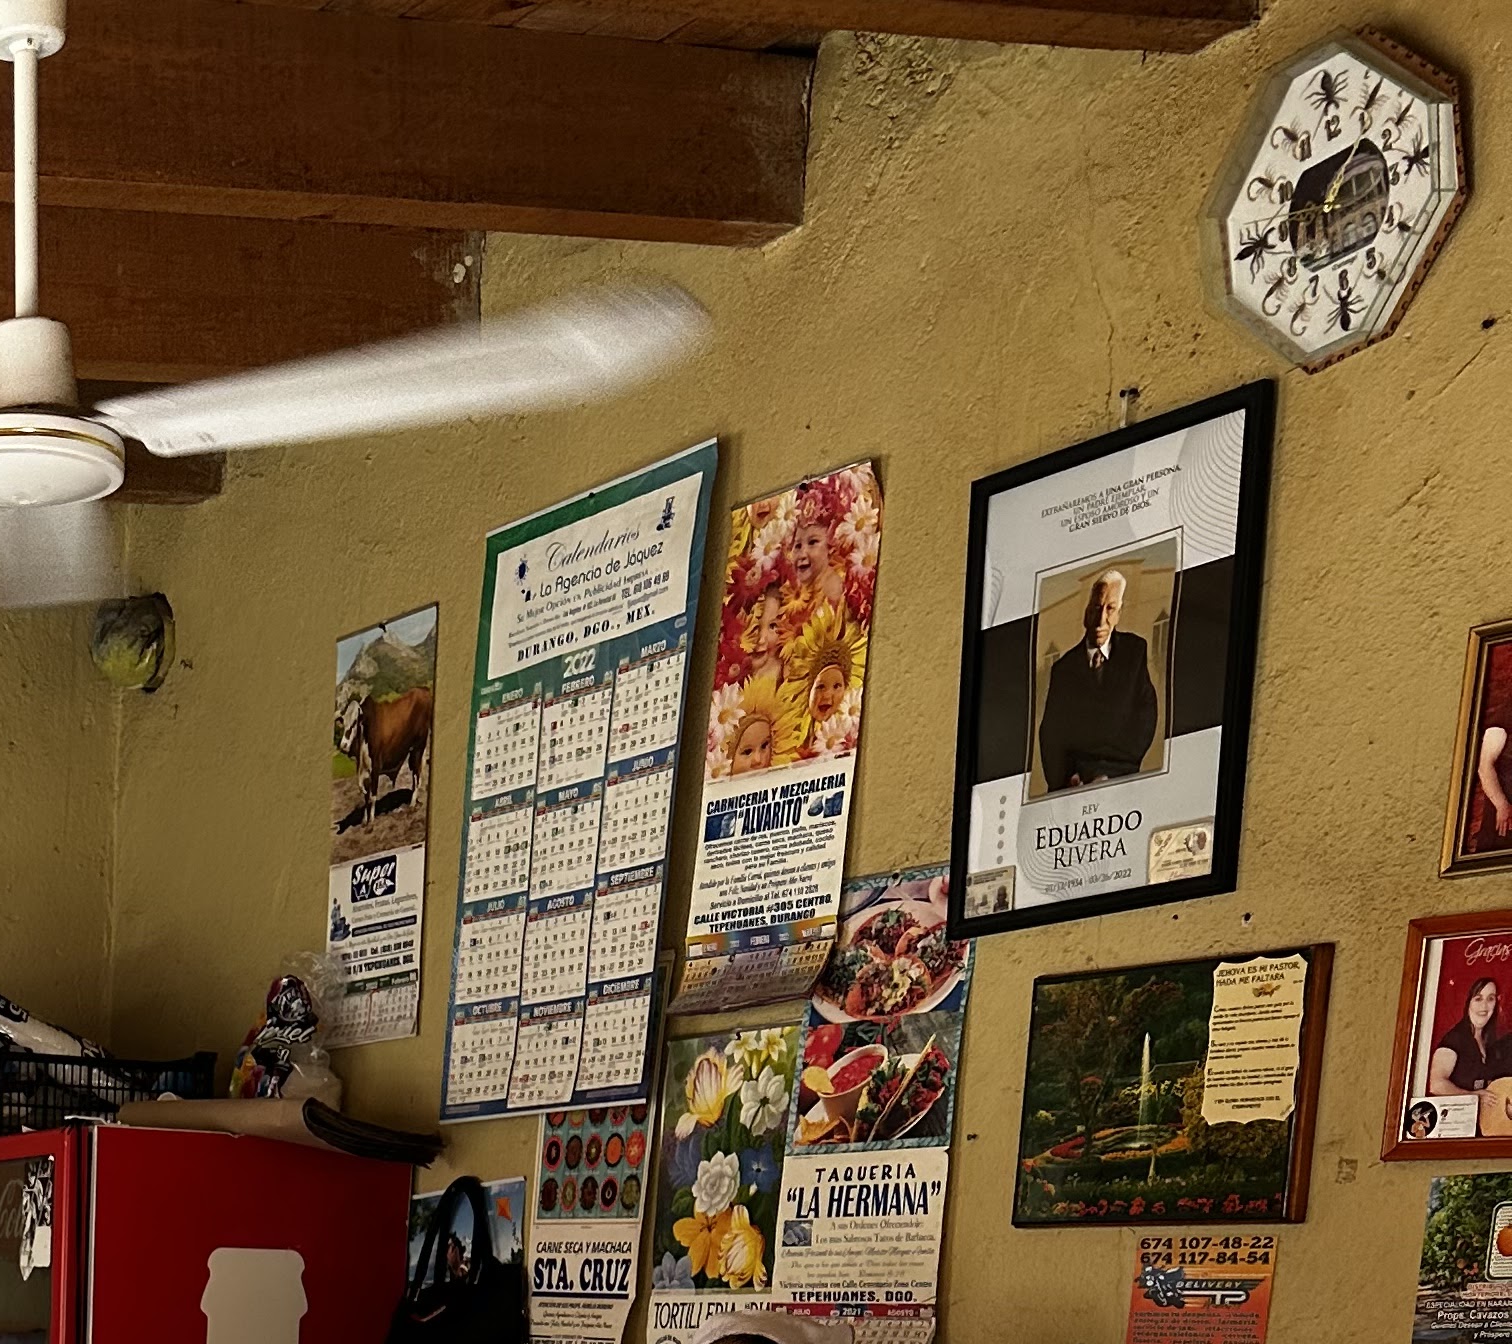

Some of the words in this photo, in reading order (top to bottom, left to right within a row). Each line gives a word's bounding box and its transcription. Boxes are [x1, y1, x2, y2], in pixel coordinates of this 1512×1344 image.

[1324, 115, 1341, 141] 12
[1382, 128, 1392, 151] 2
[1389, 162, 1400, 185] 3
[1366, 247, 1376, 269] 5
[1309, 274, 1319, 297] 7
[1122, 475, 1145, 490] GRAN
[1068, 518, 1091, 533] GRAN
[540, 583, 552, 598] La
[555, 566, 602, 593] Agencia
[605, 558, 621, 576] de
[563, 648, 596, 679] 2022
[562, 675, 595, 693] FEBRERO
[558, 788, 579, 802] MAYO
[706, 790, 768, 816] CARNICERIA
[780, 772, 846, 800] MEZCALERIA
[1036, 810, 1143, 851] EDUARDO
[1053, 837, 1128, 870] RIVERA
[352, 862, 395, 885] Super
[610, 866, 655, 886] SEPTIEMBRE
[546, 894, 575, 911] AGOSTO
[694, 911, 720, 925] CALLE
[721, 905, 765, 921] VICTORIA
[770, 908, 816, 924] DURANGO
[1216, 967, 1246, 978] JEHOVA
[1247, 966, 1257, 974] ES
[1238, 976, 1249, 985] ME
[533, 1001, 572, 1018] NOVIEMBRE
[815, 1163, 917, 1184] TAQUERIA
[536, 1241, 564, 1254] CARNE
[564, 1241, 584, 1254] SECA
[591, 1241, 633, 1254] MACHACA
[1140, 1237, 1173, 1250] 674
[1179, 1236, 1274, 1250] 107-48-22
[1140, 1252, 1173, 1265] 674
[1178, 1251, 1270, 1265] 117-84-54
[533, 1257, 574, 1291] STA.
[579, 1258, 632, 1292] CRUZ
[1176, 1280, 1242, 1289] DELIVERY
[842, 1307, 861, 1316] 2021
[1469, 1309, 1509, 1319] Cavazos
